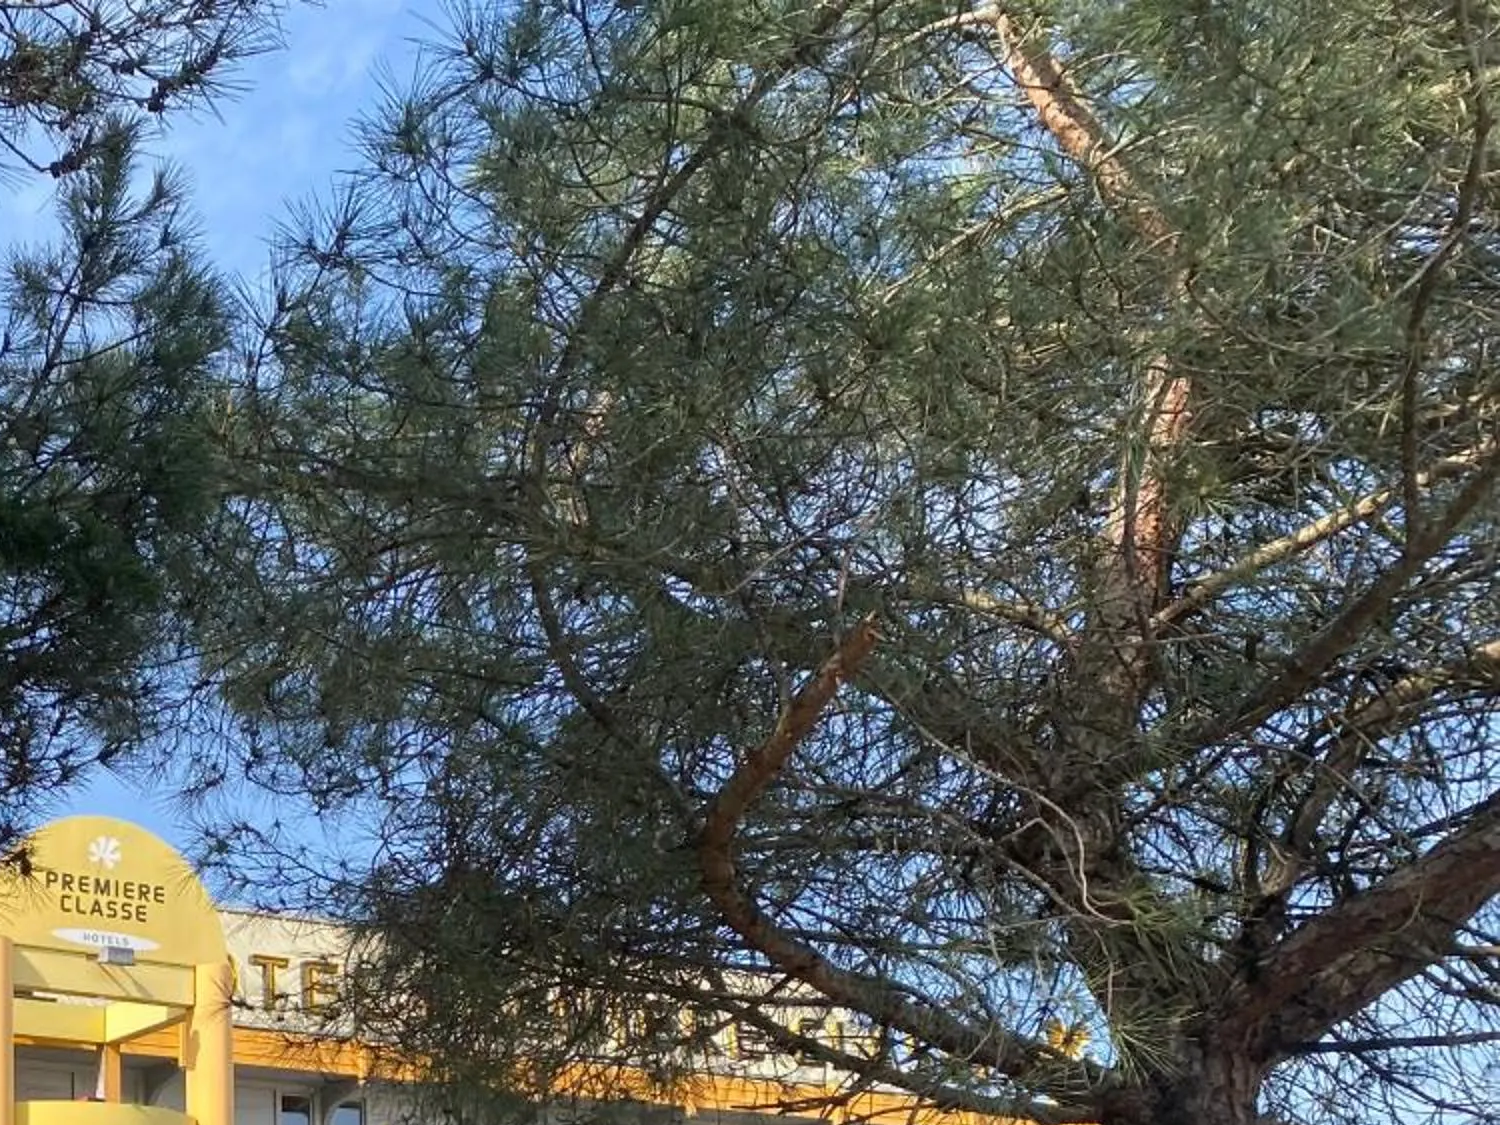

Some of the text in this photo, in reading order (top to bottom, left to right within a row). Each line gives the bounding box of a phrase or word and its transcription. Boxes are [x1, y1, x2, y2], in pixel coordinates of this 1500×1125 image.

[45, 871, 166, 904] PREMIERE
[59, 895, 148, 922] CLASSE
[83, 931, 131, 946] HOTELS
